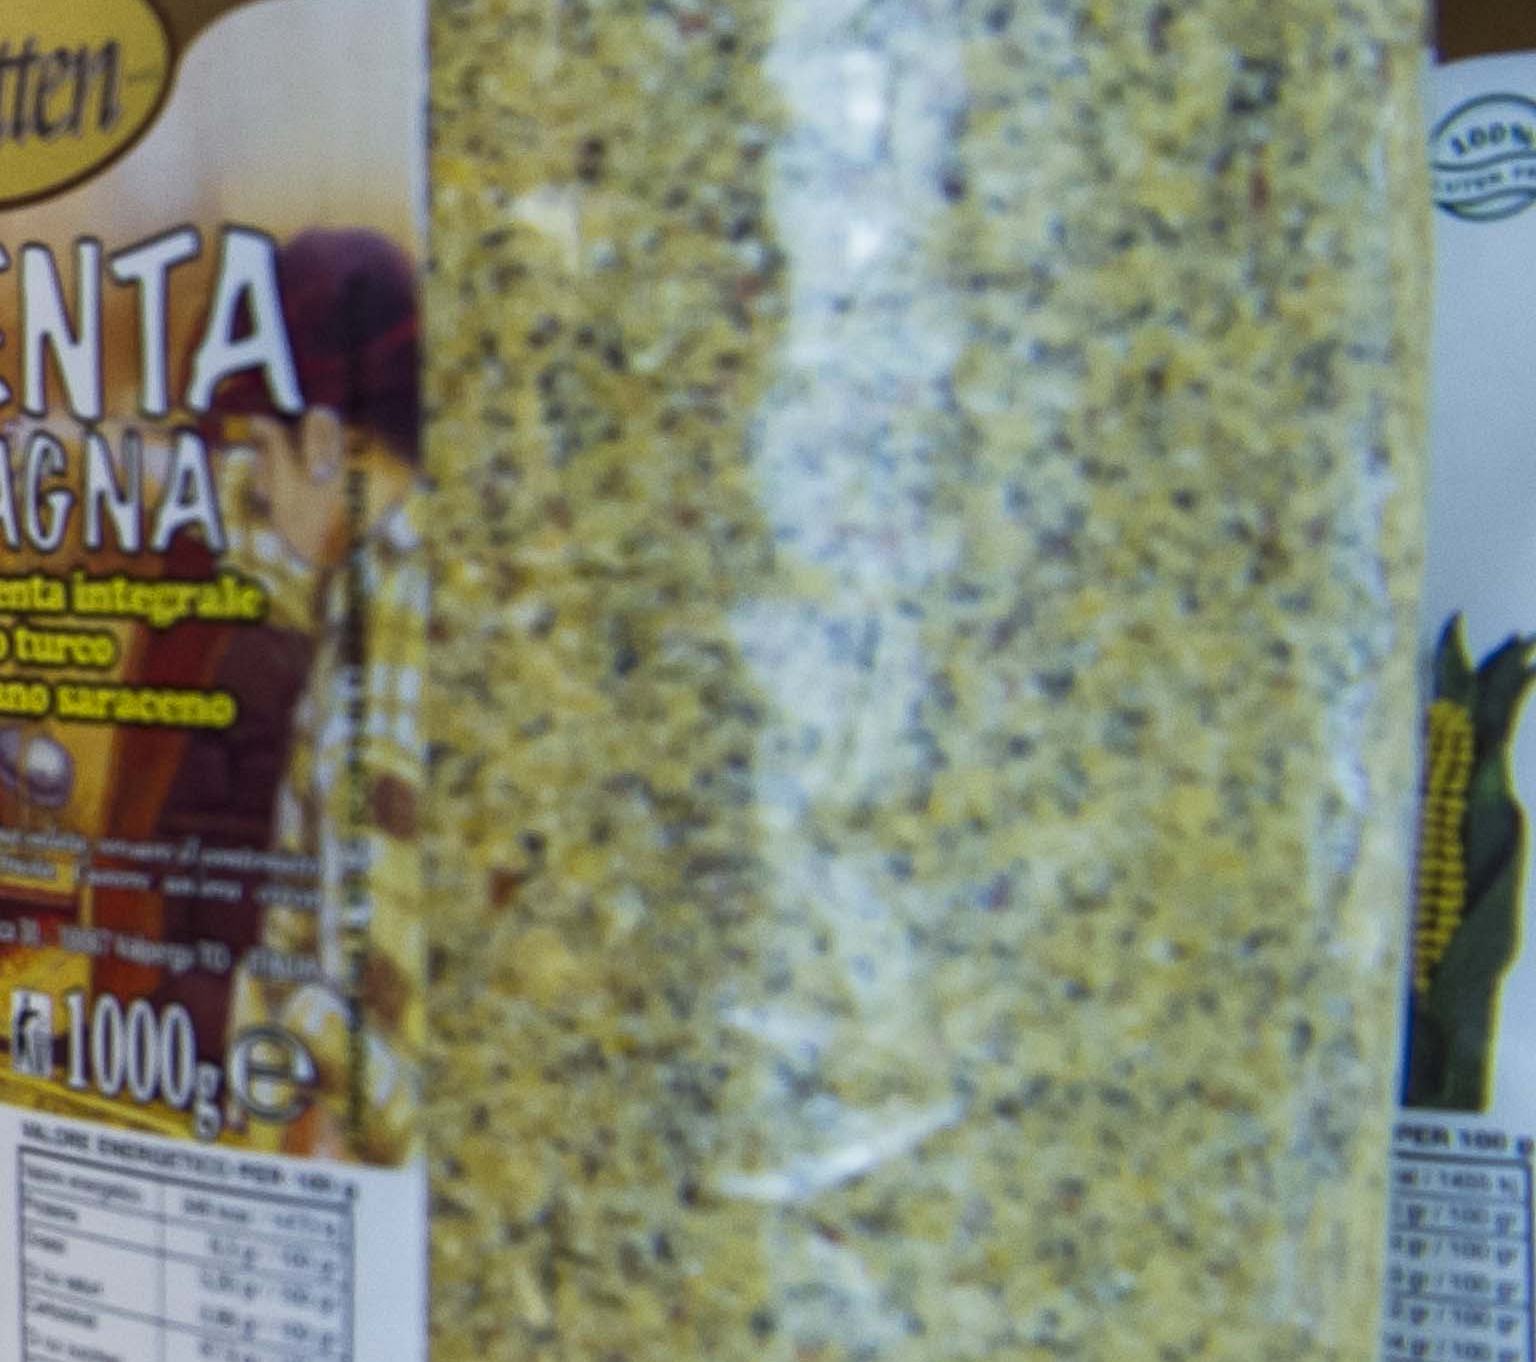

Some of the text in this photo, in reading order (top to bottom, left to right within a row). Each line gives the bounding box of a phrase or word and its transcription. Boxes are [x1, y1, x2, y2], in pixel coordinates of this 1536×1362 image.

[71, 569, 268, 629] integrale
[14, 626, 118, 667] turco
[56, 681, 238, 729] saraceno
[65, 992, 195, 1111] 1000
